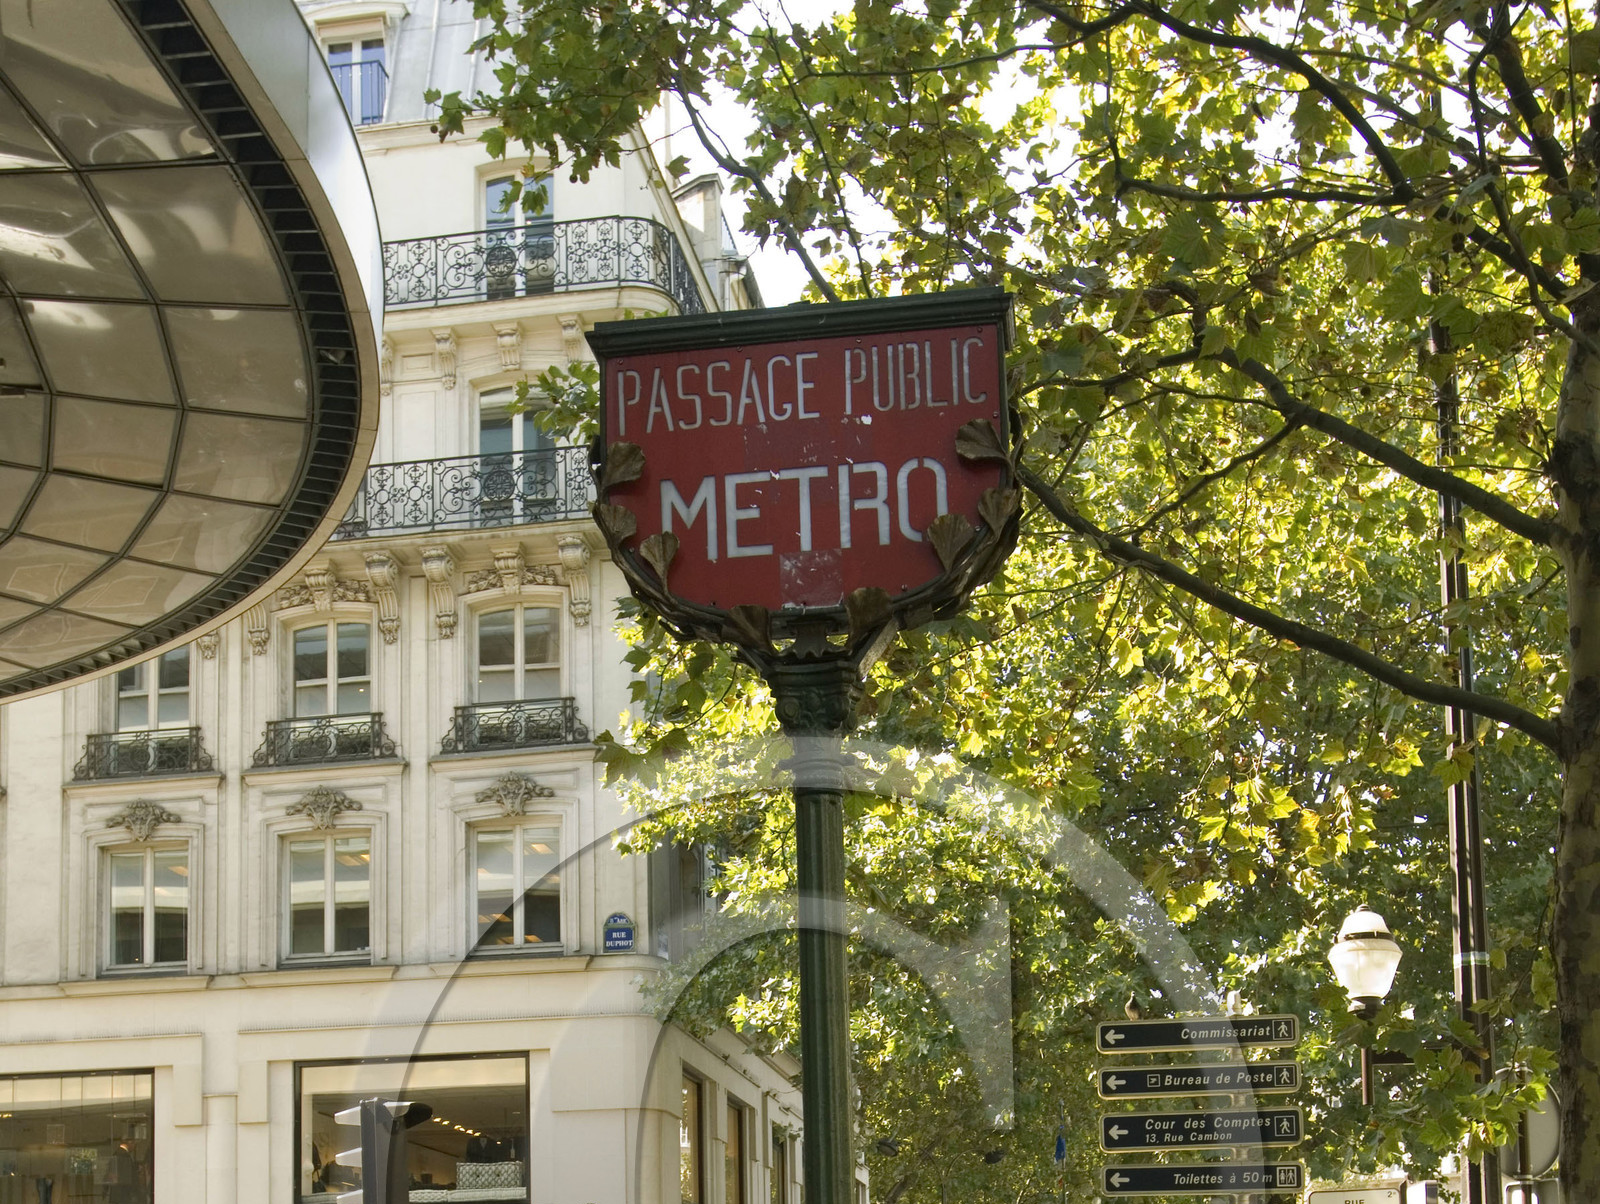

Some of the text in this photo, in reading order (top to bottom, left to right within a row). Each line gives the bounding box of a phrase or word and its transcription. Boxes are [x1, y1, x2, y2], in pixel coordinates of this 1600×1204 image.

[617, 336, 987, 436] PASSAGE PUBLIC
[660, 457, 948, 561] METRO
[1181, 1026, 1271, 1040] Commissariat
[1164, 1072, 1273, 1086] Bureau de Poste
[1145, 1117, 1271, 1130] Cour des Comptes
[1145, 1132, 1232, 1144] 13, Rue Cambon
[1173, 1173, 1223, 1185] Toilettes
[1229, 1173, 1236, 1184] à
[1242, 1172, 1259, 1183] 50
